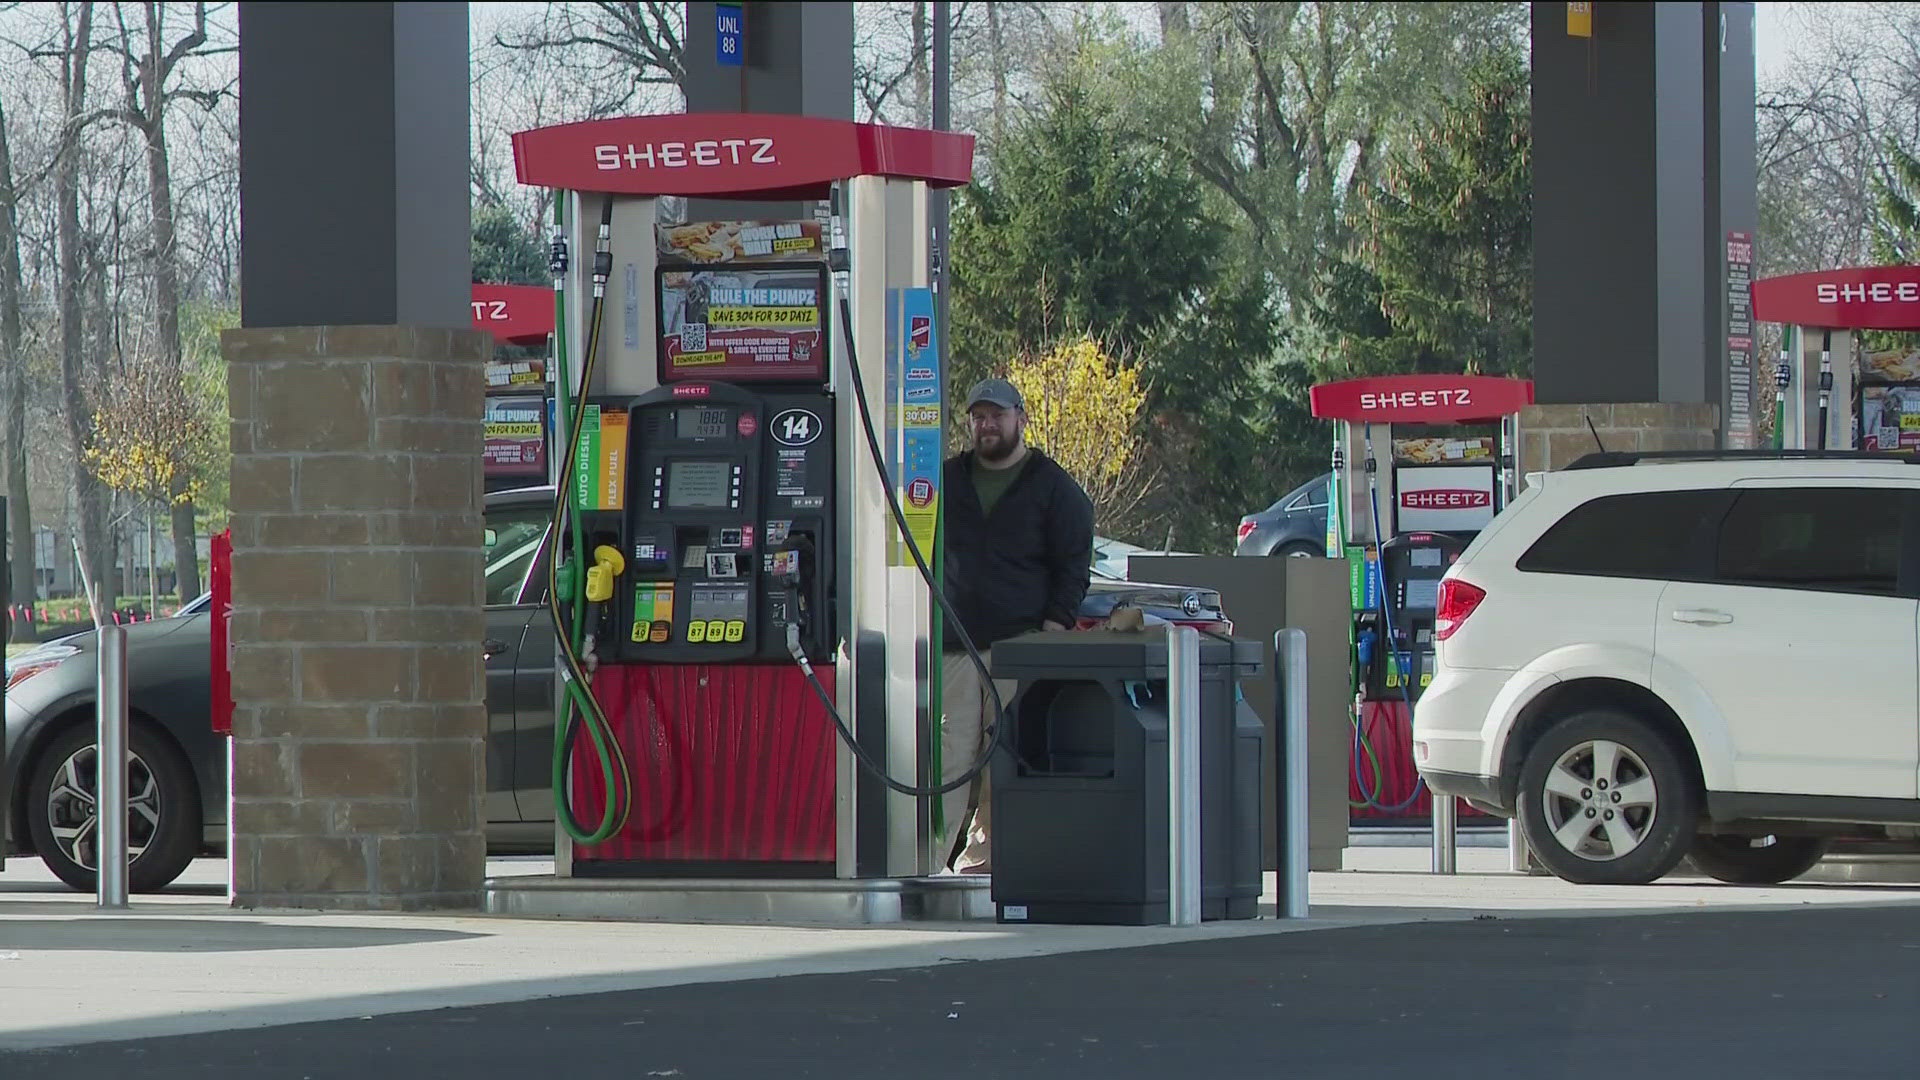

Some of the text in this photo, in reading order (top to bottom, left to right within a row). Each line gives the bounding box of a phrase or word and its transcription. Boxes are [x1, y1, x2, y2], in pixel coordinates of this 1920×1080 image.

[718, 15, 740, 34] UNL
[722, 36, 736, 54] 88
[594, 137, 776, 171] SHEETZ
[710, 288, 816, 306] RULE THE PUMPZ
[713, 311, 734, 322] SAVE
[755, 310, 772, 322] FOR
[774, 310, 788, 322] 30
[790, 310, 812, 322] DAYZ
[709, 338, 724, 346] WITH
[725, 338, 743, 346] OFFER
[744, 338, 760, 346] CODE
[734, 346, 750, 354] SAVE
[758, 346, 777, 354] EVERY
[777, 346, 790, 354] DAY
[755, 354, 774, 362] AFTER
[674, 387, 706, 395] SHEETZ
[1360, 388, 1472, 410] SHEETZ
[489, 409, 540, 422] THE PUMPZ
[920, 410, 938, 421] OFF
[496, 425, 509, 435] FOR
[510, 425, 520, 434] 30
[520, 425, 538, 434] DAYZ
[783, 415, 810, 439] 14
[579, 433, 590, 506] AUTO DIESEL
[608, 449, 618, 506] FLEX FUEL
[1406, 492, 1485, 506] SHEETZ
[691, 628, 702, 637] 87
[709, 628, 721, 637] 89
[728, 627, 740, 636] 93
